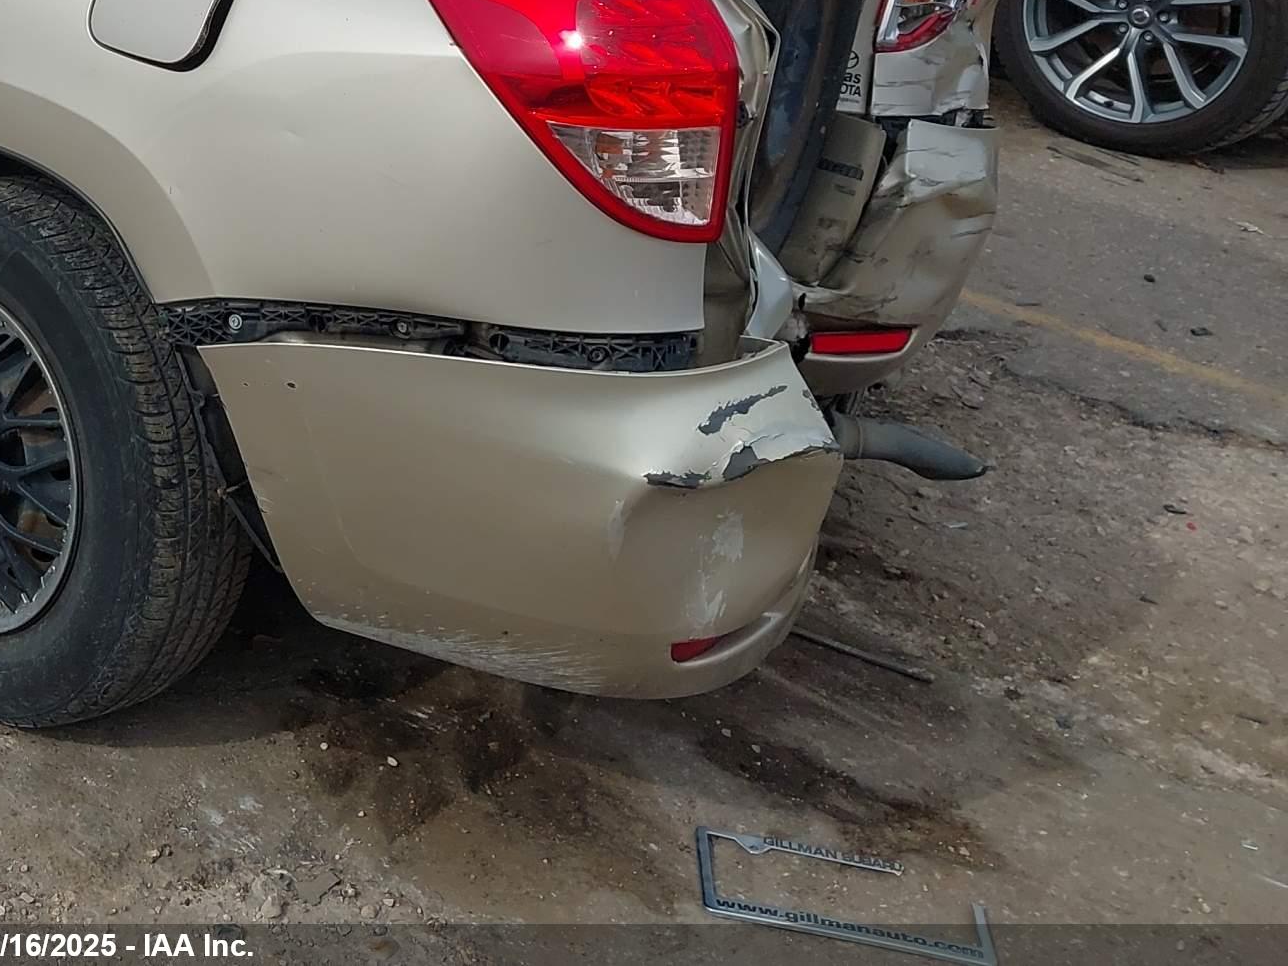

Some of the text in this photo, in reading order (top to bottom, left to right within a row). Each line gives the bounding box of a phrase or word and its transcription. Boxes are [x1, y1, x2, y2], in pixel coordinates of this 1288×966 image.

[842, 72, 862, 85] as
[839, 83, 862, 97] OTA
[763, 836, 838, 860] GILLMAN
[715, 898, 985, 959] www.gillmanauto.com
